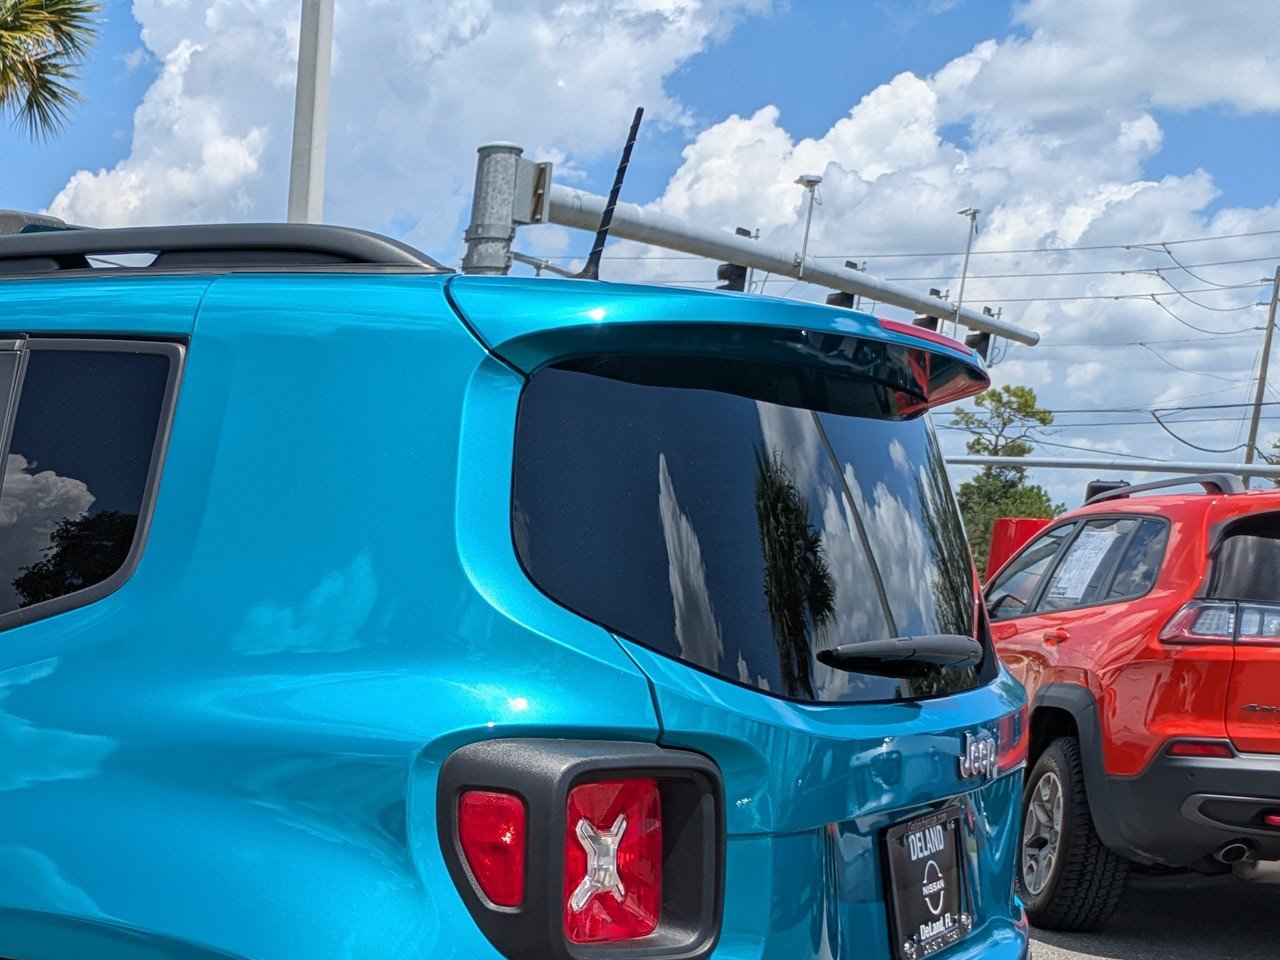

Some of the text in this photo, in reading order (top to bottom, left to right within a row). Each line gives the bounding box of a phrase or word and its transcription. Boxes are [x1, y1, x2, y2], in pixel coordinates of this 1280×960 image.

[959, 730, 996, 779] Jeep
[909, 824, 944, 861] DELAND
[922, 879, 945, 896] NISSAN
